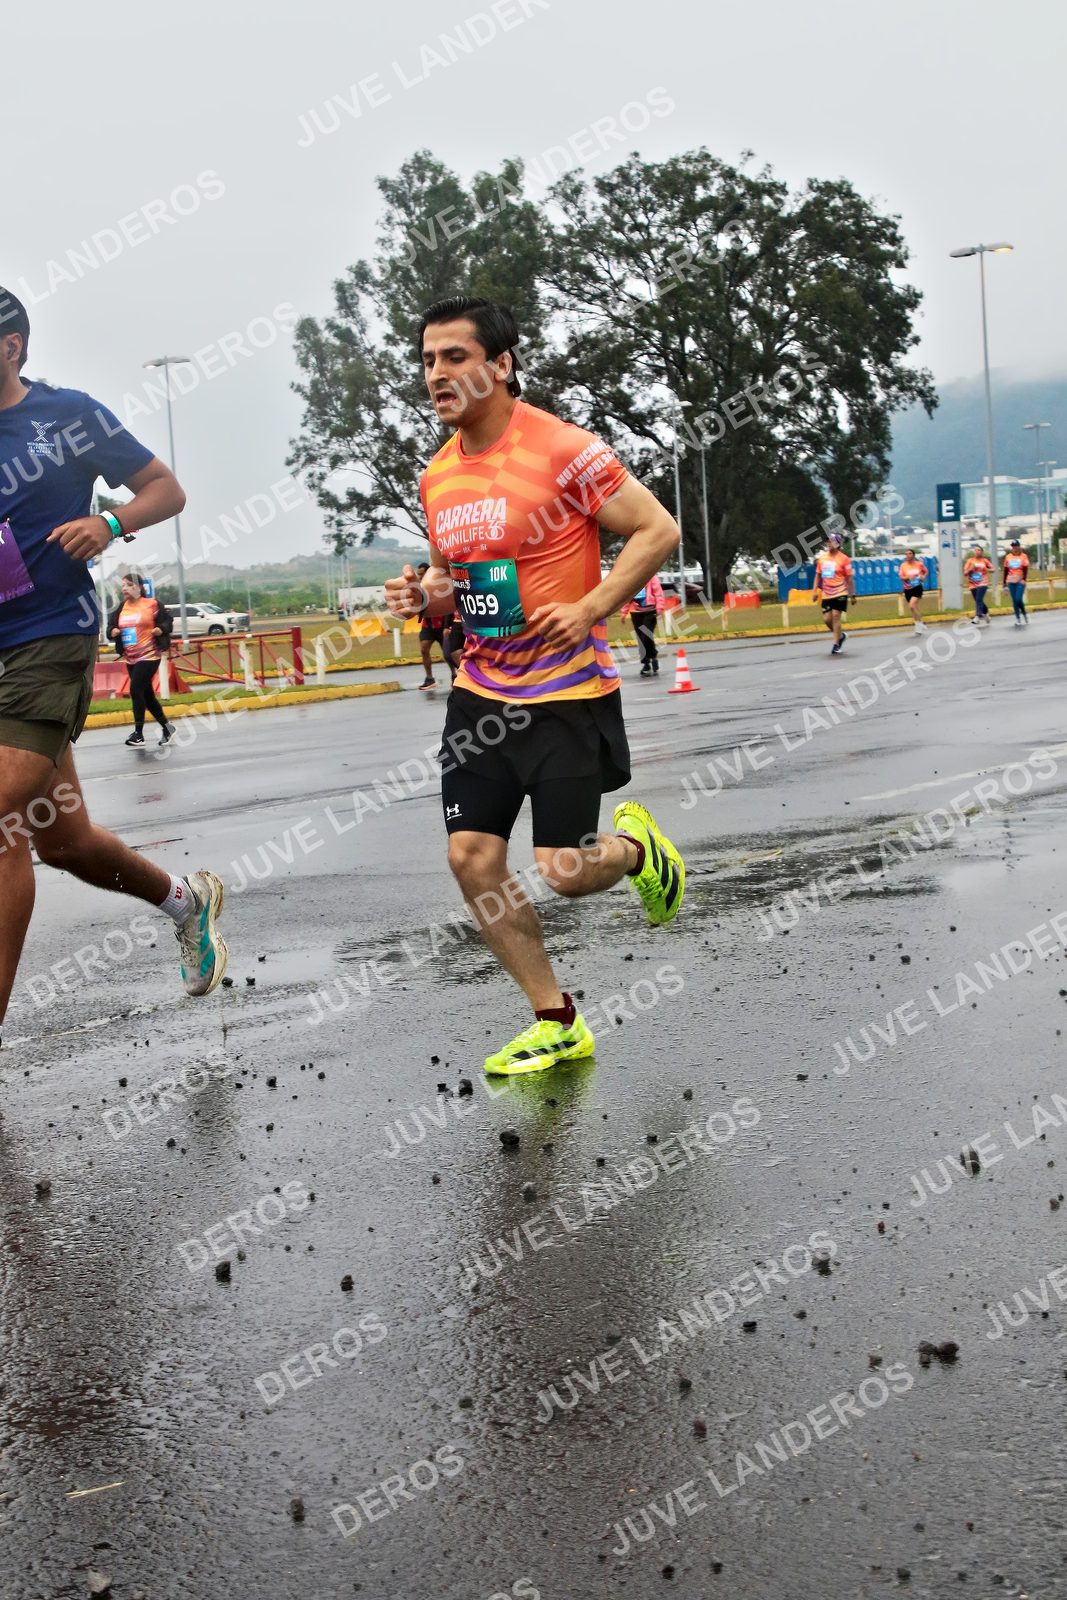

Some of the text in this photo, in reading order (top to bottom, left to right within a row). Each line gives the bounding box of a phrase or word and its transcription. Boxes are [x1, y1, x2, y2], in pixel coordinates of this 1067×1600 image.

[435, 497, 507, 535] CARRERA
[941, 499, 955, 517] E
[437, 525, 485, 552] OMNILIFE
[489, 566, 508, 582] 10K
[460, 593, 500, 616] 1059
